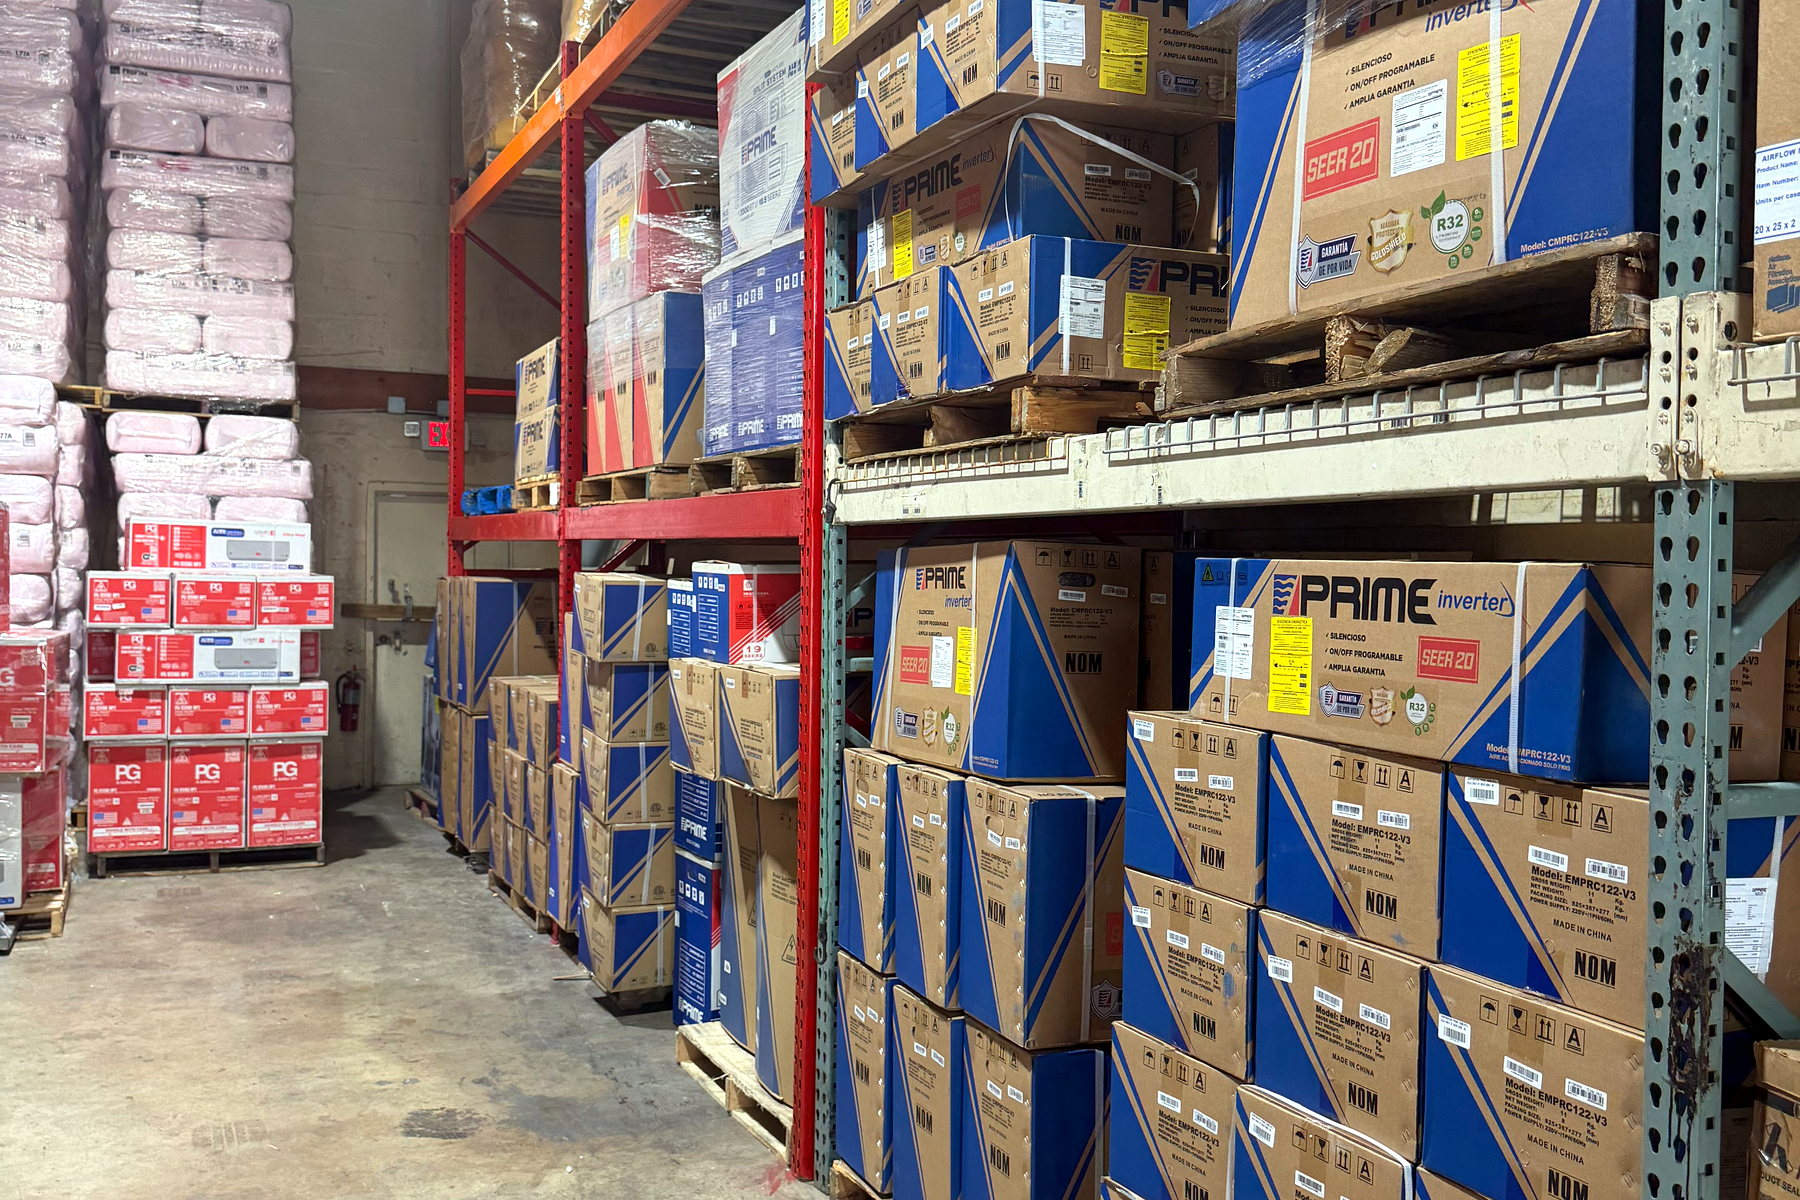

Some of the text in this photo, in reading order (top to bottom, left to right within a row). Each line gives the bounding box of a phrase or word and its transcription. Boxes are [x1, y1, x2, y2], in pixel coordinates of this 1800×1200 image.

[1425, 0, 1501, 33] inverte
[1163, 40, 1232, 55] ON/OFF PROGRAMABLE
[1163, 52, 1218, 64] AMPLIA GARANTIA
[1350, 53, 1435, 92] ON/OFF PROGRAMABLE
[1351, 52, 1393, 74] SILENCIOSO
[963, 64, 978, 86] NOM
[1349, 79, 1415, 109] AMPLIA GARANTIA
[892, 109, 904, 131] NOM
[747, 125, 777, 160] PRIME
[1307, 137, 1375, 183] SEER 20
[1757, 160, 1799, 173] Product Name:
[1762, 149, 1796, 162] AIRFLOW
[905, 152, 963, 207] PRIME
[1772, 176, 1799, 187] Number:
[1756, 196, 1772, 205] Units
[1774, 194, 1784, 203] per
[1115, 225, 1142, 242] NOM
[1437, 215, 1463, 231] R32
[1755, 225, 1764, 234] 20
[1766, 224, 1771, 233] x
[1773, 221, 1782, 231] 25
[1791, 219, 1796, 228] 2
[1321, 241, 1348, 258] GARANTÍA
[1371, 232, 1406, 261] GOLDSHIELD
[1520, 239, 1546, 253] Model:
[1319, 259, 1352, 276] DE POR VIDA
[1768, 263, 1776, 271] Air
[1159, 261, 1228, 298] PRI
[996, 341, 1010, 361] NOM
[910, 362, 922, 378] NOM
[429, 422, 449, 446] EX
[925, 566, 966, 589] PRIME
[944, 595, 972, 609] inverter
[1301, 575, 1508, 625] PRIME inverter
[1330, 632, 1366, 642] SILENCIOSO
[902, 656, 928, 674] SEER 20
[1066, 653, 1102, 672] NOM
[1329, 648, 1403, 662] ON/OFF PROGRAMABLE
[1421, 649, 1474, 670] SEER 20
[1328, 664, 1385, 676] AMPLIA GARANTIA
[1409, 703, 1425, 711] R32
[1519, 748, 1571, 763] MPRC122-V3
[115, 764, 141, 780] PG
[195, 764, 220, 779] PG
[273, 761, 298, 777] PG
[1175, 784, 1235, 804] Model: EMPRC122-V3
[686, 818, 708, 841] PRIME
[1188, 822, 1201, 830] MADE
[1208, 826, 1222, 836] CHINA
[1332, 819, 1411, 844] Model: EMPRC122-V3
[858, 848, 871, 870] NOM
[1201, 845, 1225, 869] NOM
[1349, 864, 1365, 873] MADE
[1374, 870, 1393, 881] CHINA
[1532, 866, 1636, 900] Model: EMPRC122-V3
[917, 872, 932, 897] NOM
[988, 898, 1006, 926] NOM
[1366, 890, 1397, 919] NOM
[1553, 919, 1612, 942] MADE IN CHINA
[1168, 946, 1225, 976] Model: EMPRC122-V3
[1575, 950, 1616, 986] NOM
[1181, 987, 1213, 1006] MADE IN CHINA
[683, 1000, 704, 1024] PRIME
[1194, 1012, 1216, 1040] NOM
[1316, 1005, 1391, 1042] Model: EMPRC122-V3
[856, 1059, 870, 1085] NOM
[1332, 1053, 1348, 1065] MADE
[1356, 1064, 1374, 1077] CHINA
[1348, 1082, 1378, 1116] NOM
[1506, 1077, 1608, 1127] Model: EMPRC122-V3
[916, 1104, 932, 1134] NOM
[1159, 1110, 1220, 1147] Model: EMPRC122-V3
[990, 1144, 1009, 1177] NOM
[1527, 1134, 1584, 1165] MADE IN CHINA
[1172, 1153, 1185, 1165] MADE
[1192, 1163, 1206, 1176] CHINA
[1185, 1180, 1209, 1200] NOM
[1548, 1168, 1589, 1200] NOM
